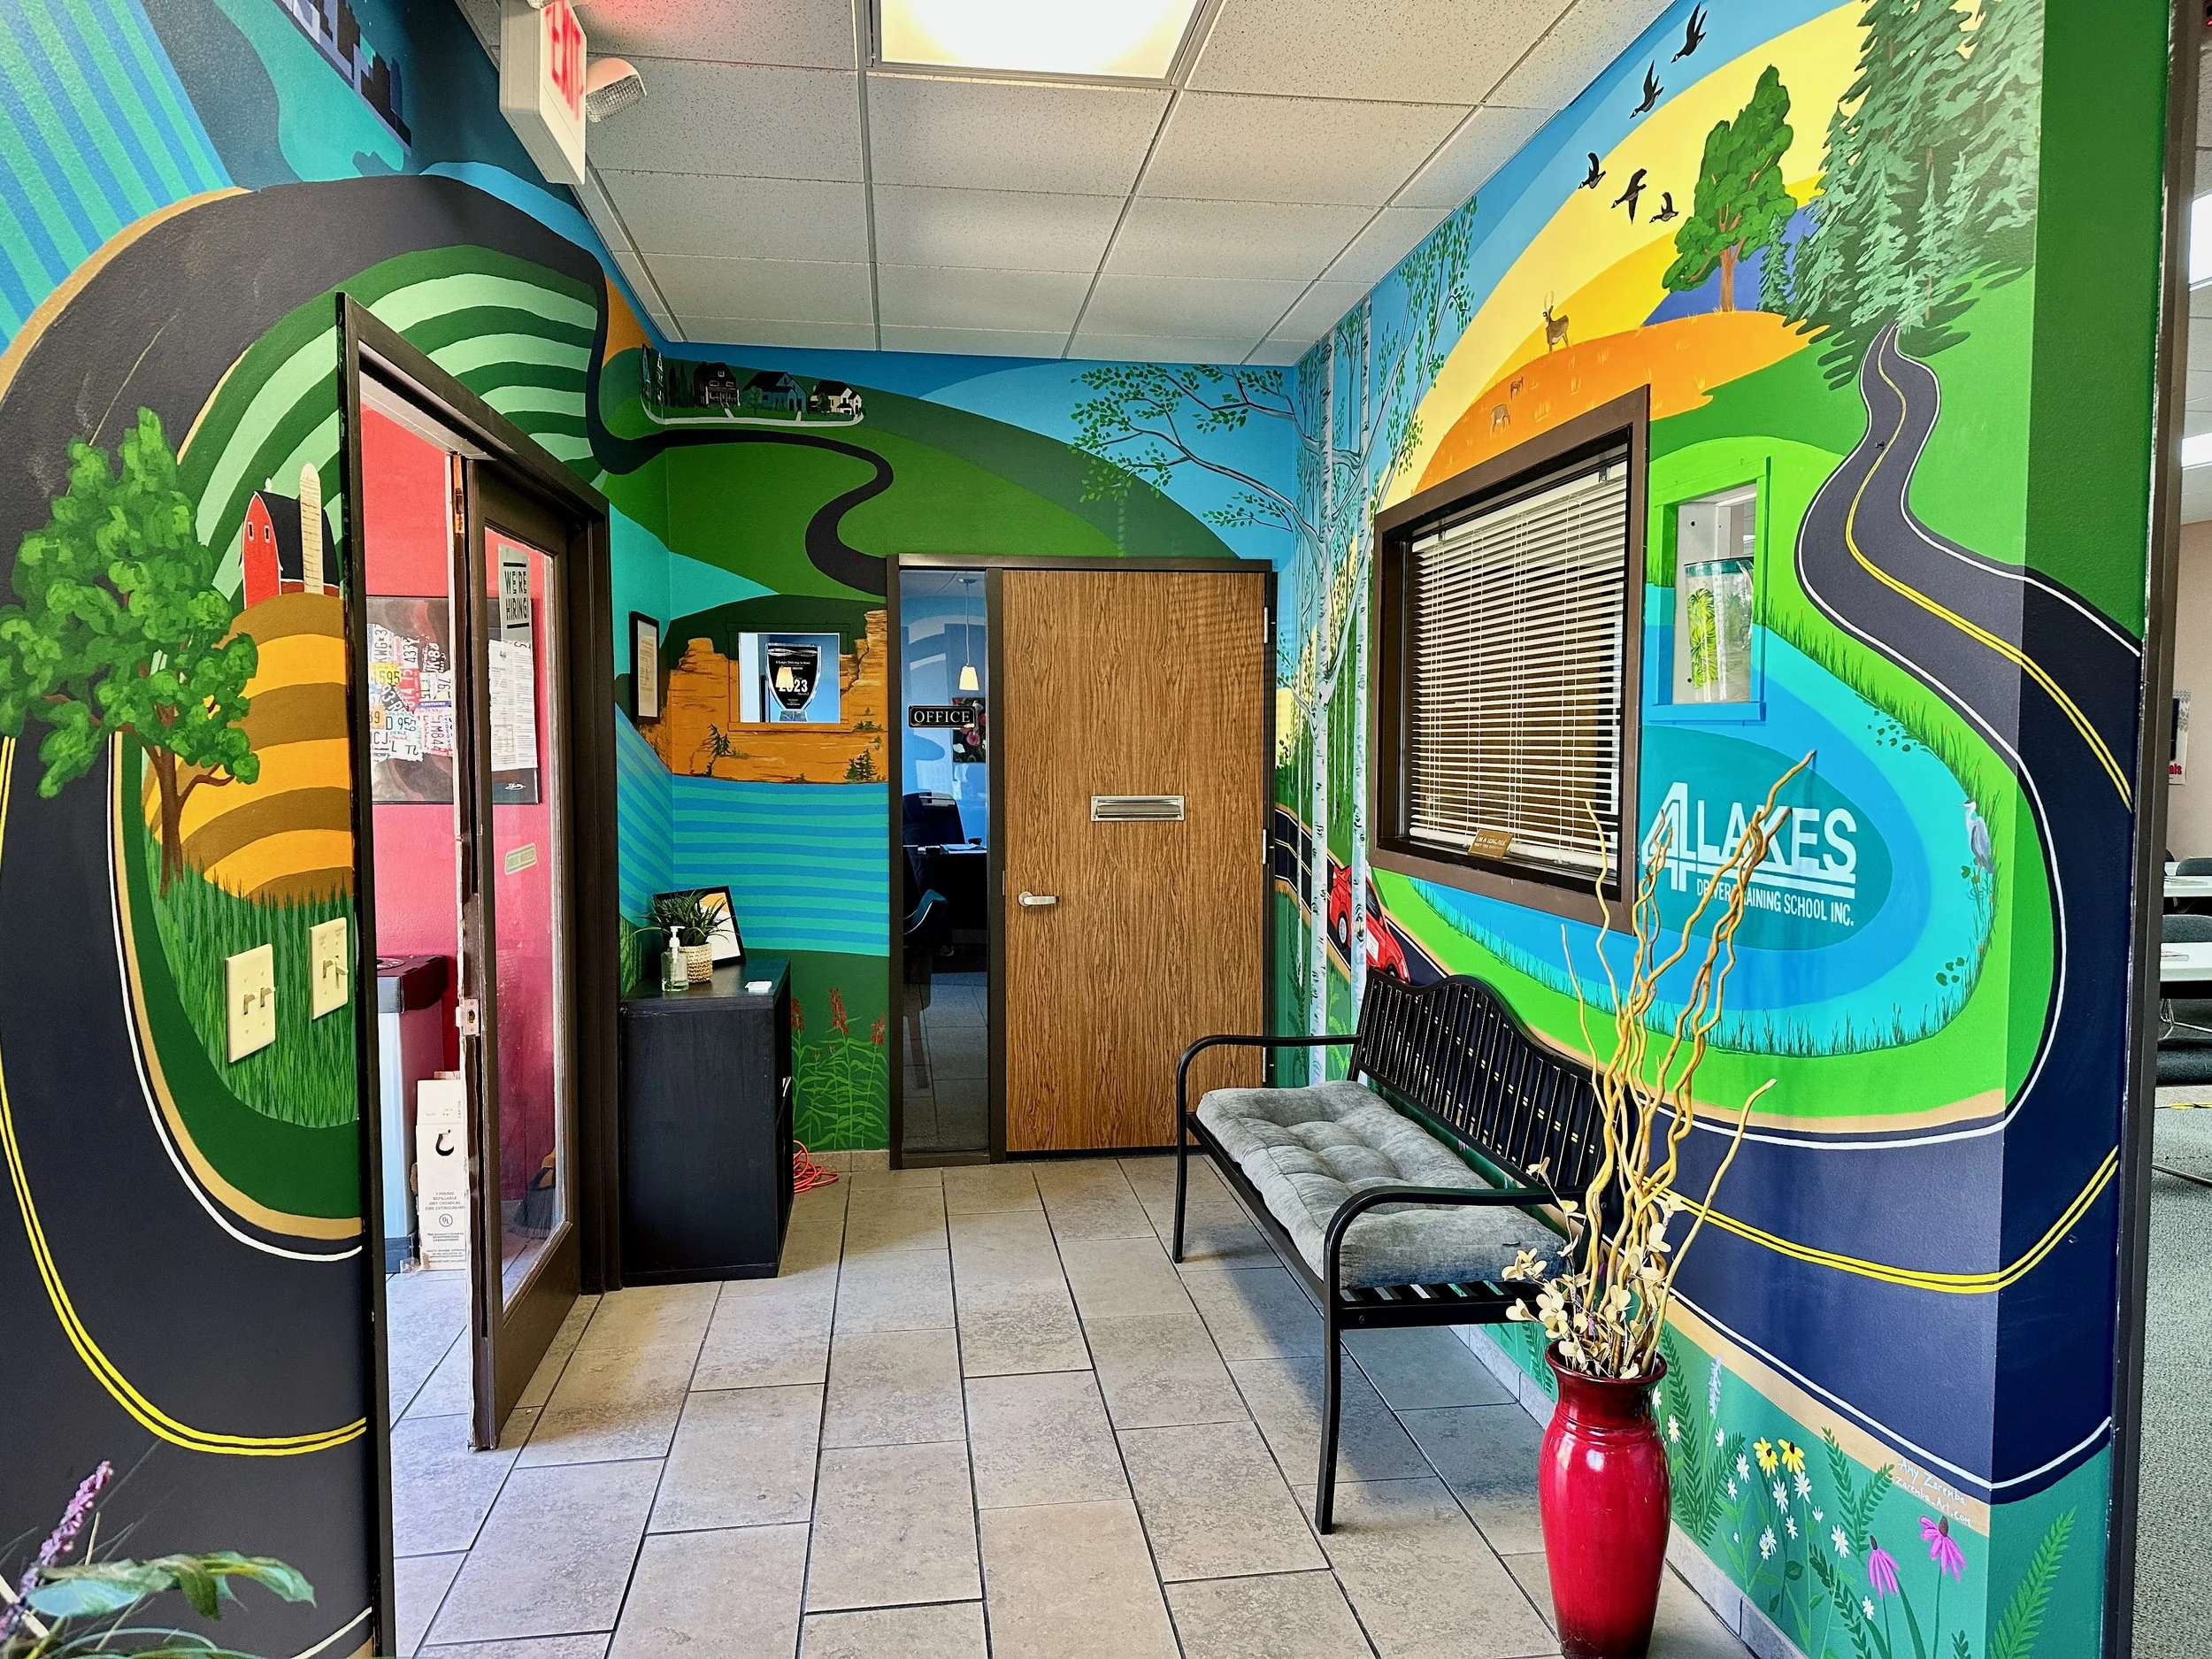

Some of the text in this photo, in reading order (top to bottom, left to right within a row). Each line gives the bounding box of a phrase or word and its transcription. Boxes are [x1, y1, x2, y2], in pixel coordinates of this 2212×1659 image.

[504, 571, 527, 594] WE'RE
[913, 710, 971, 724] OFFICE
[1641, 781, 1857, 892] 4 LAKES
[1696, 878, 1855, 926] DRVER AINING SCHOOL INC.
[1923, 1471, 1966, 1505] Zaremba
